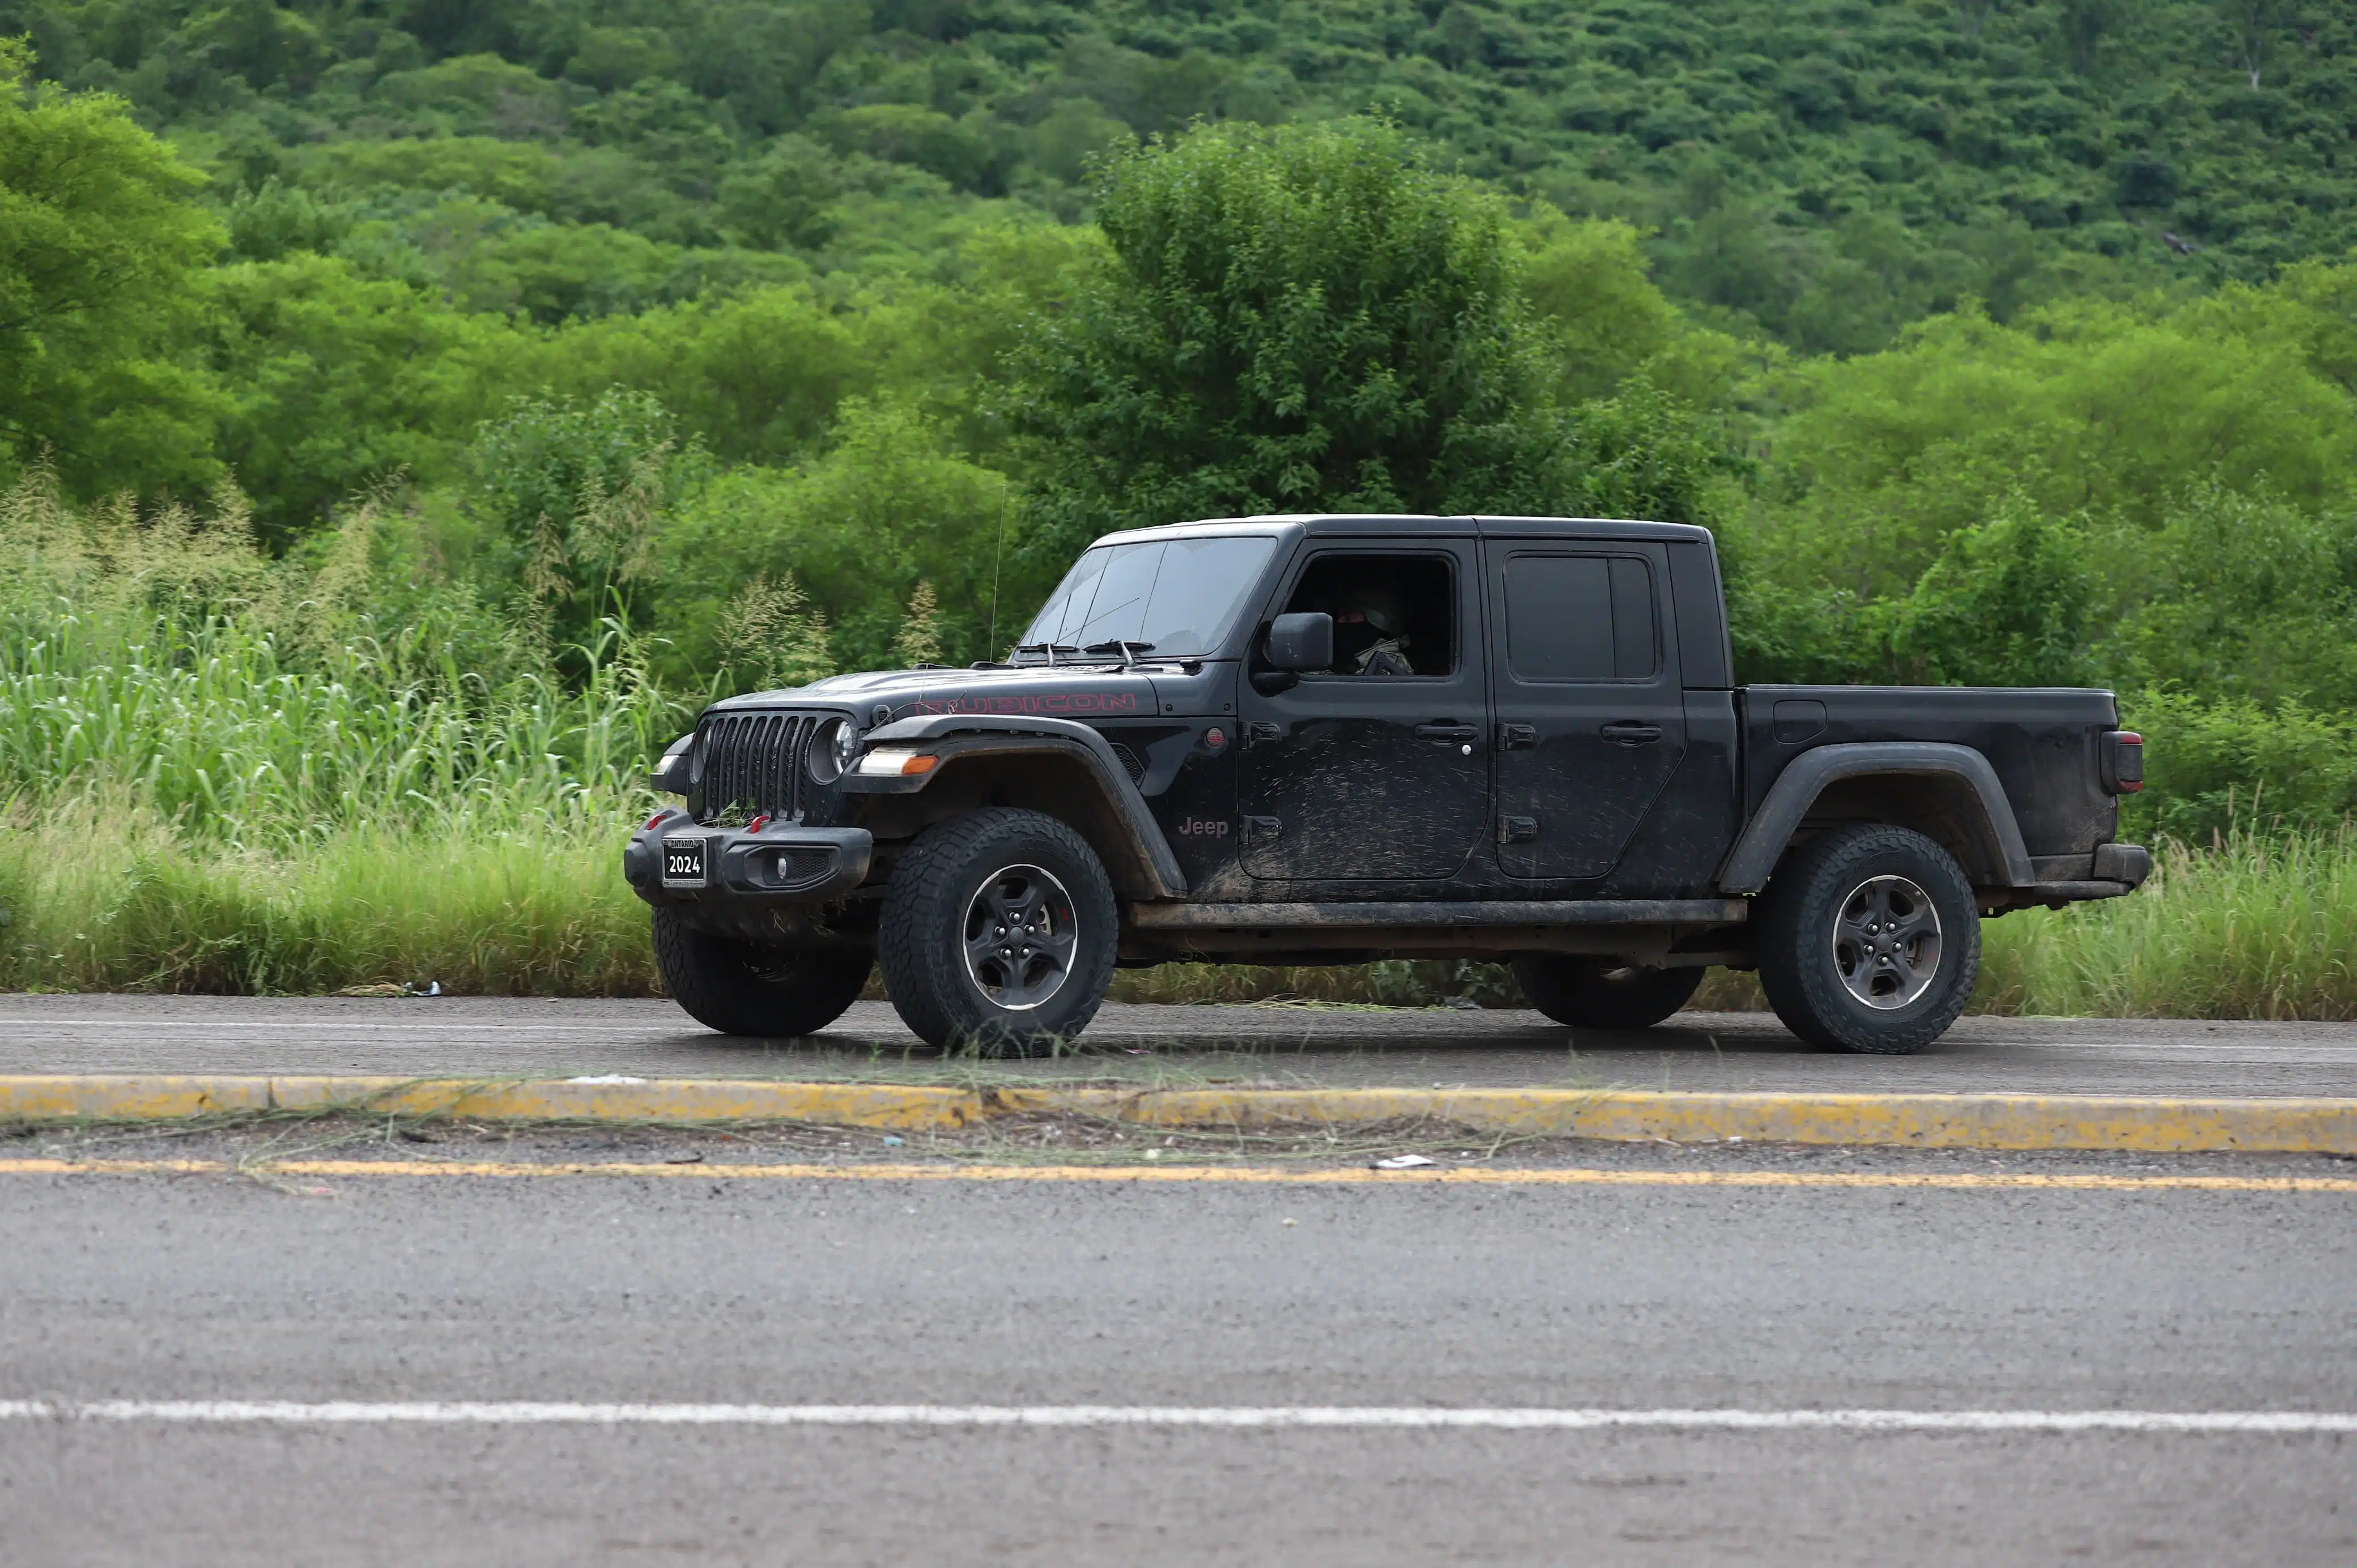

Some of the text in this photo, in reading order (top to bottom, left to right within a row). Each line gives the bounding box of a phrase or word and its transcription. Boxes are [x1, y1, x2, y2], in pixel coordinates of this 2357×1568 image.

[915, 693, 1135, 716] RUBICON
[1178, 816, 1228, 838] Jeep
[671, 840, 694, 848] ONTARIO
[669, 855, 700, 873] 2024
